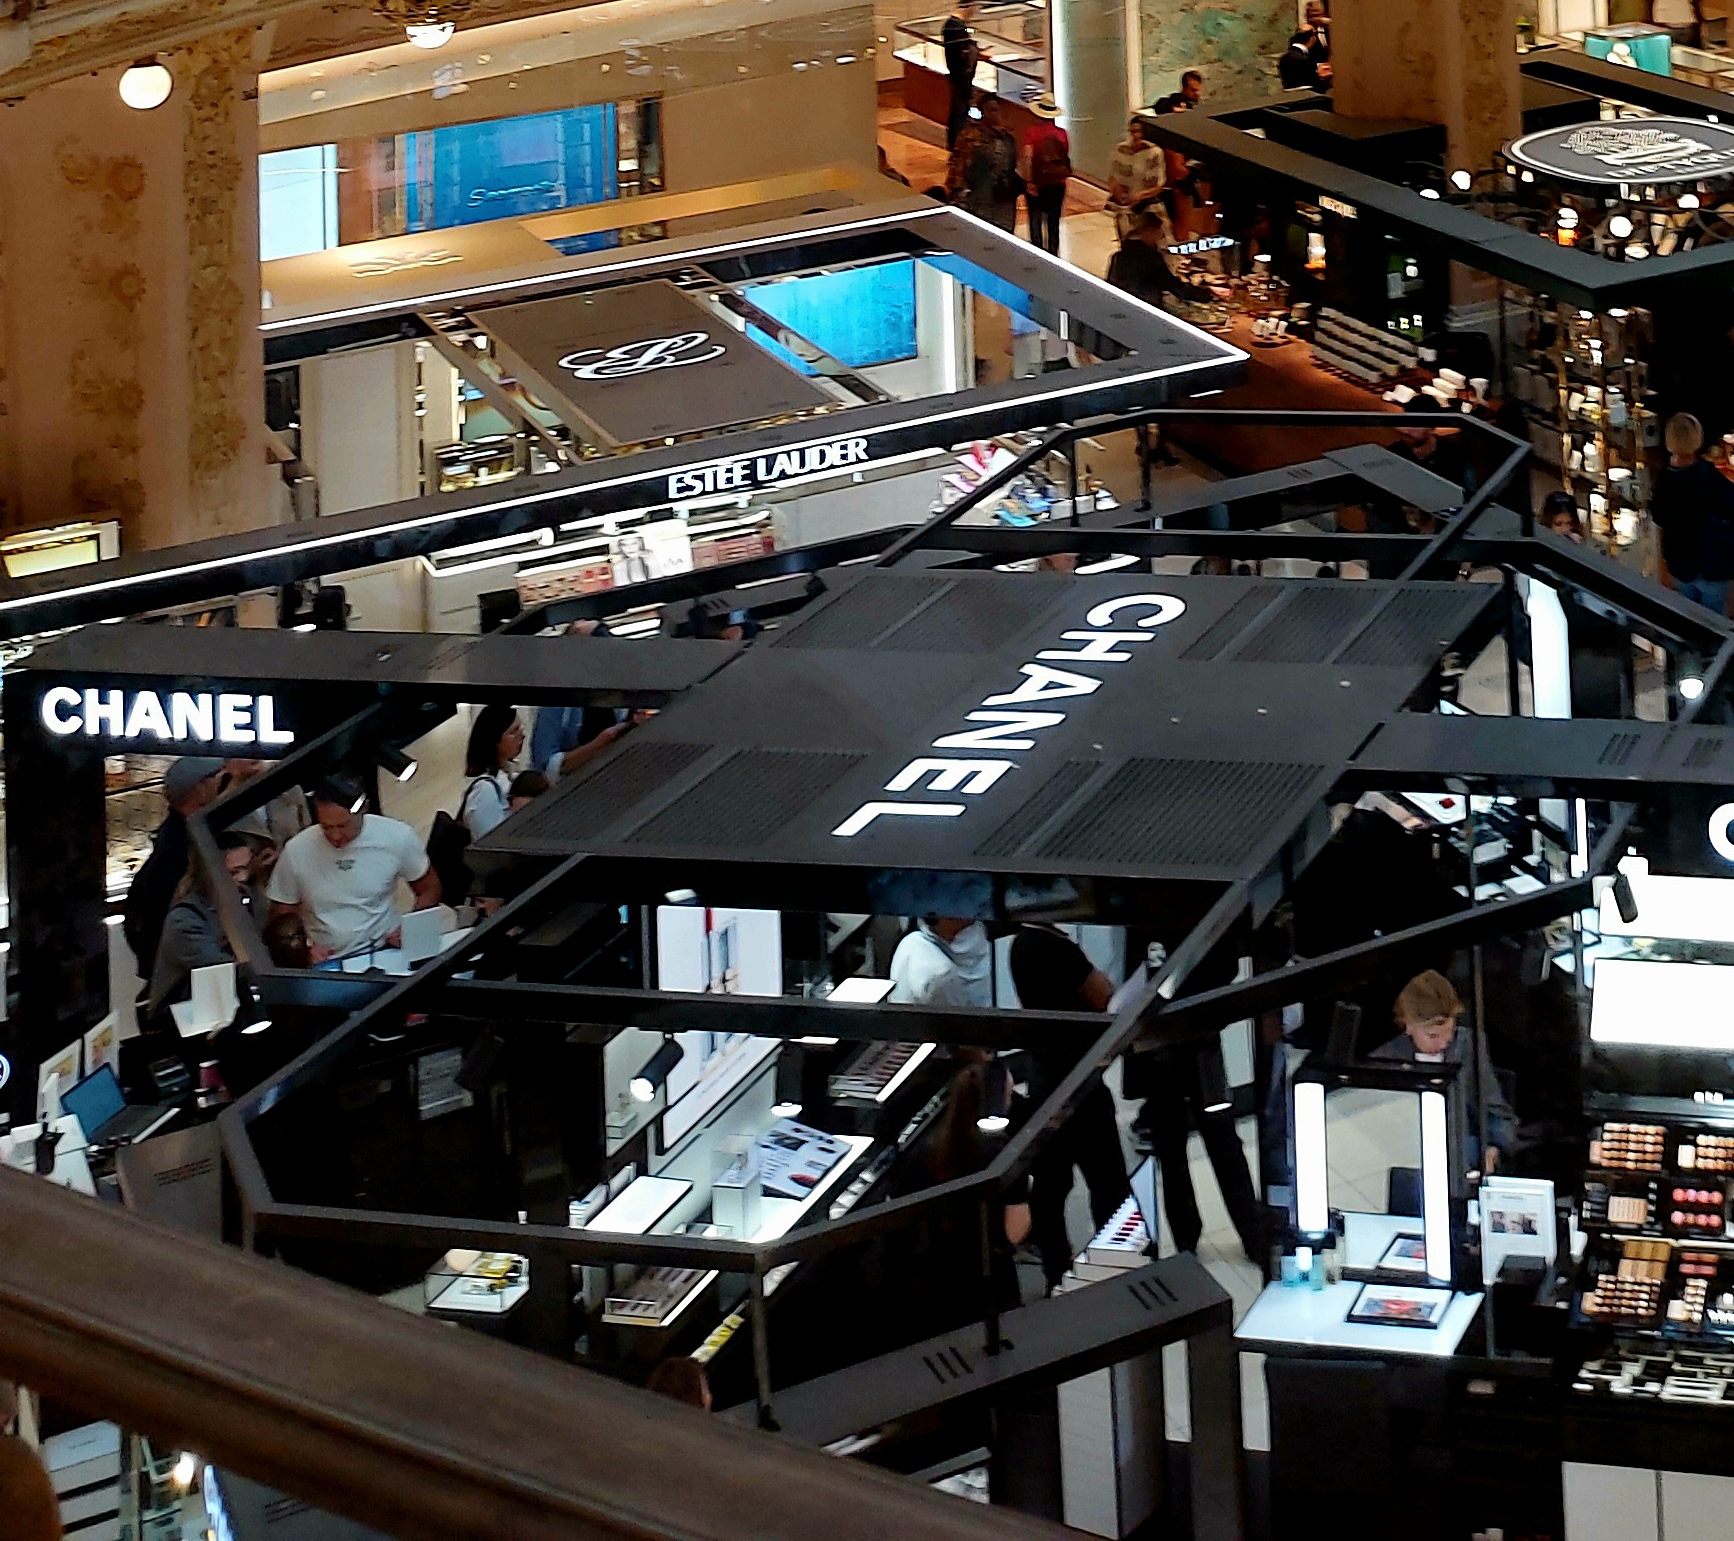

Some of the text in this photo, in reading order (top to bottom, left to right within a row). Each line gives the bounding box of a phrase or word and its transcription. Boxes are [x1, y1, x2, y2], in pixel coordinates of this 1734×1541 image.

[756, 437, 869, 480] LAUDER
[40, 685, 295, 746] CHANEL
[831, 592, 1187, 838] CHANEL
